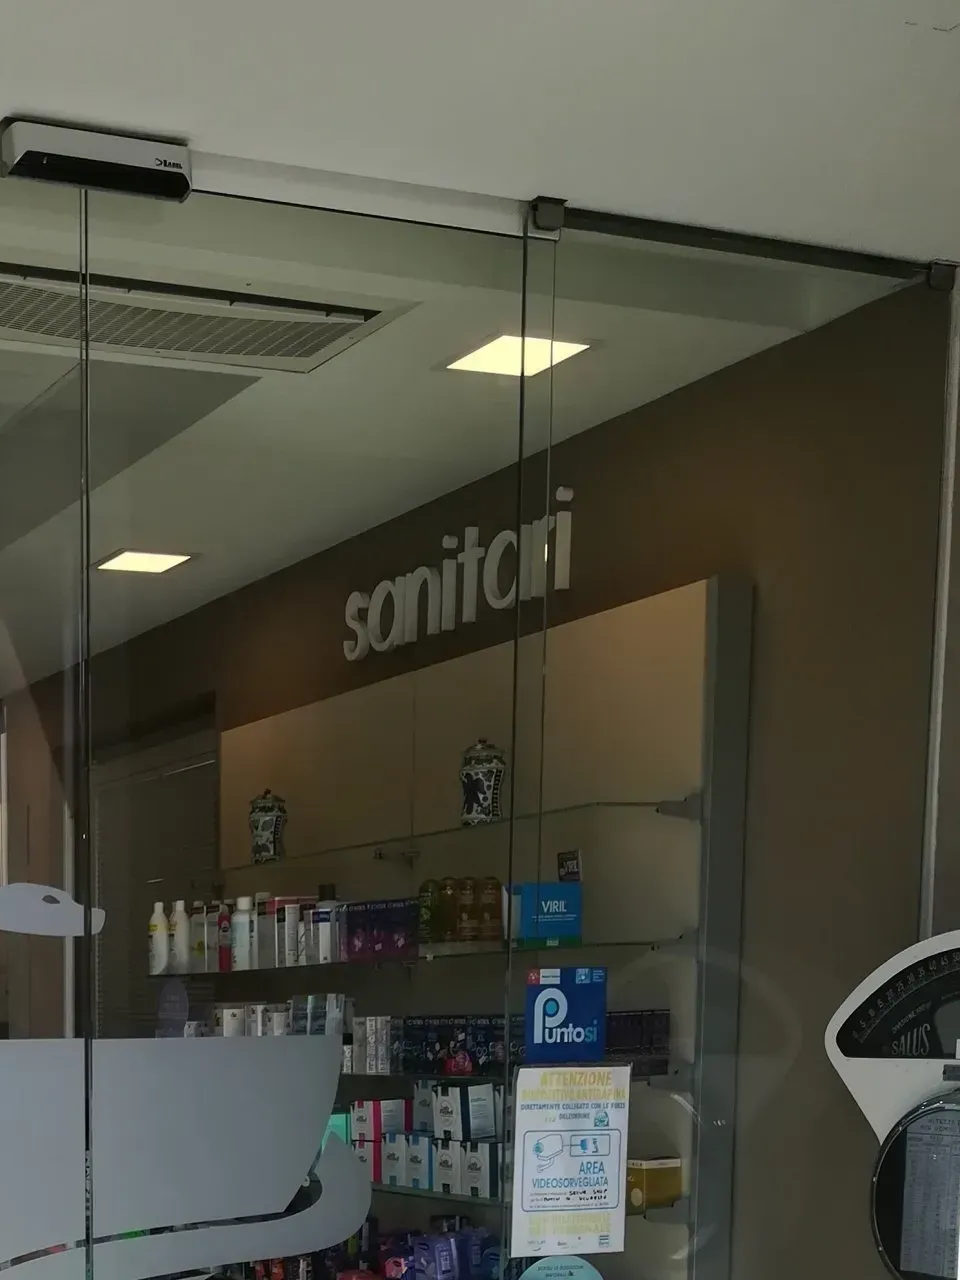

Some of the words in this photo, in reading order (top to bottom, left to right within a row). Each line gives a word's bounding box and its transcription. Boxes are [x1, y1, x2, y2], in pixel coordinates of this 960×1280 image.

[343, 486, 574, 661] sanitari
[542, 900, 567, 913] VIRIL
[891, 1023, 931, 1056] SALUS
[540, 1070, 612, 1087] ATTENZIONE
[579, 1161, 606, 1175] AREA
[532, 1176, 609, 1189] VIDEOSORVEGLIATA
